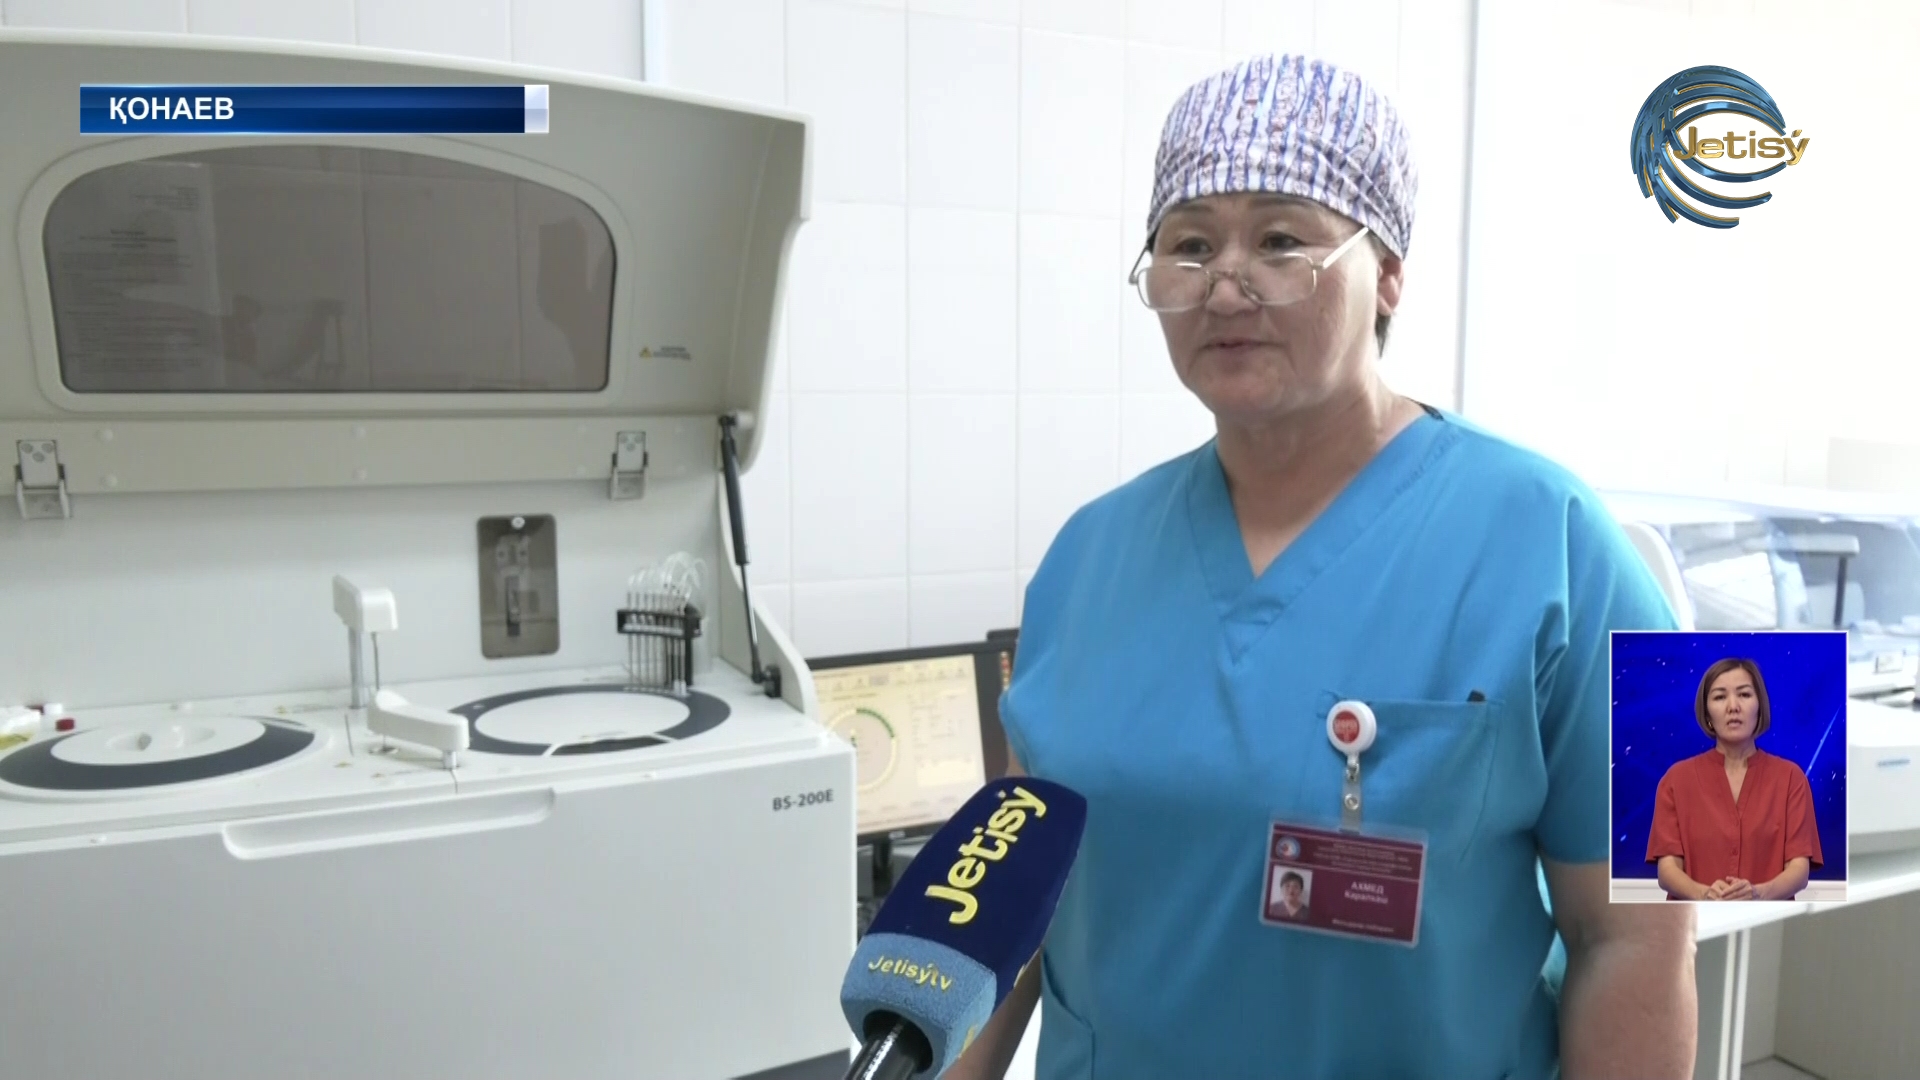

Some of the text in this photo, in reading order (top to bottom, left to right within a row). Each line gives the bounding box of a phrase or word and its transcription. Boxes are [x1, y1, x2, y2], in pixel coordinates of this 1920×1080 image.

[772, 788, 834, 811] BS-200E
[925, 786, 1047, 925] Jetisý
[1351, 881, 1385, 895] АХМЕД
